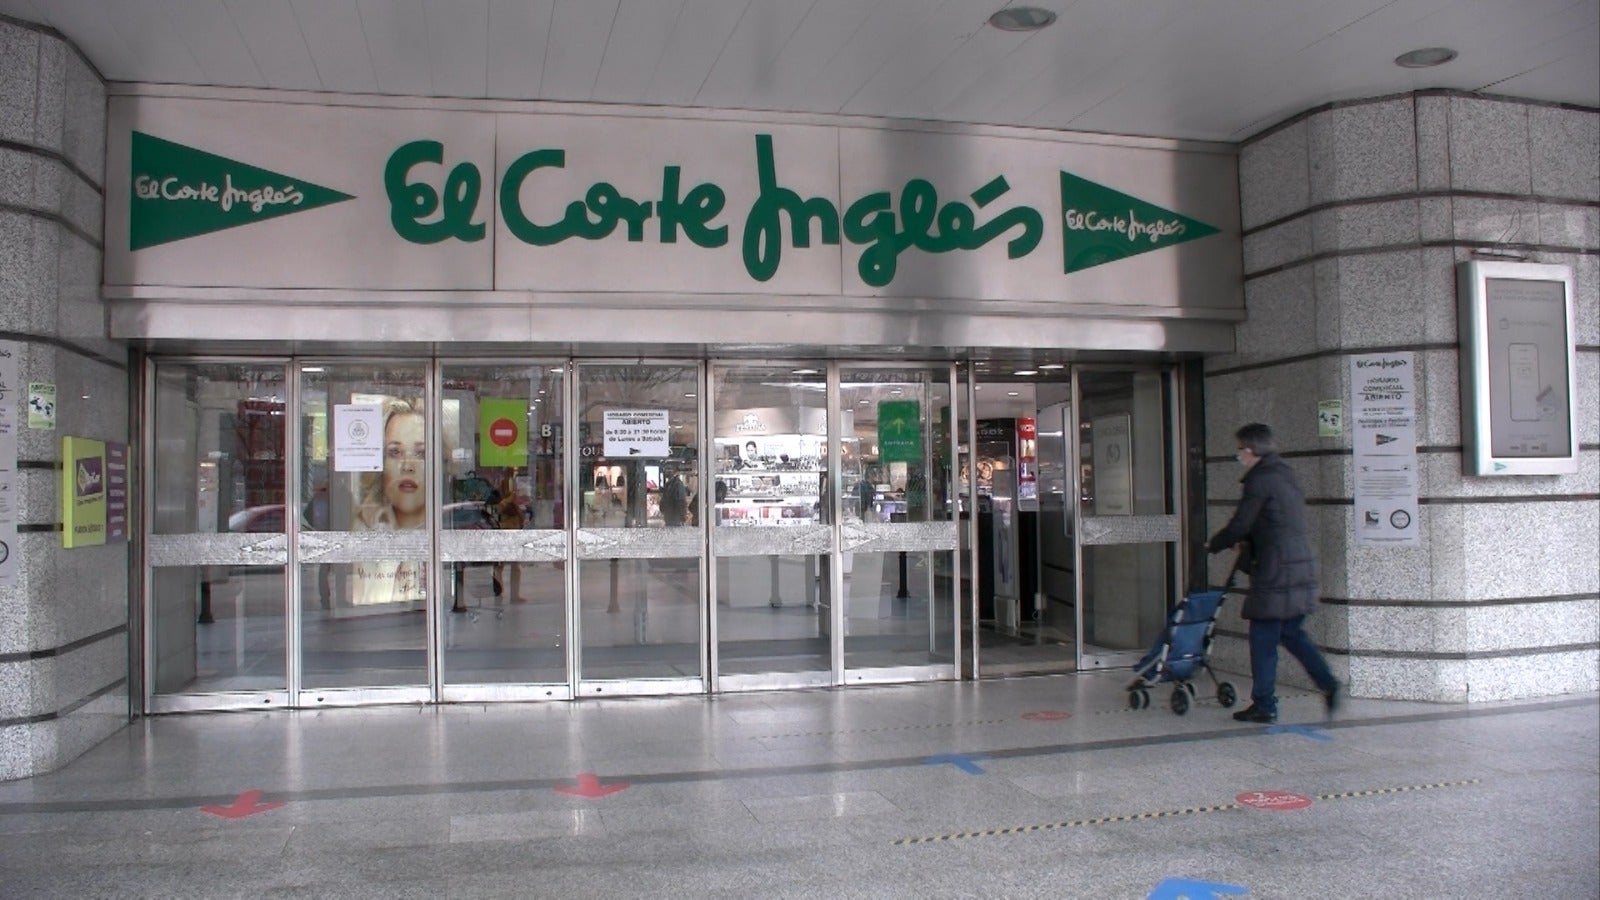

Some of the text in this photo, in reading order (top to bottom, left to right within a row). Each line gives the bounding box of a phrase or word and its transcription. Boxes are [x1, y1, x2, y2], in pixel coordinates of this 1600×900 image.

[135, 174, 303, 213] El Corte Inglés
[385, 134, 1043, 286] El Corte Inglés
[1065, 209, 1186, 243] El Corte Inglés
